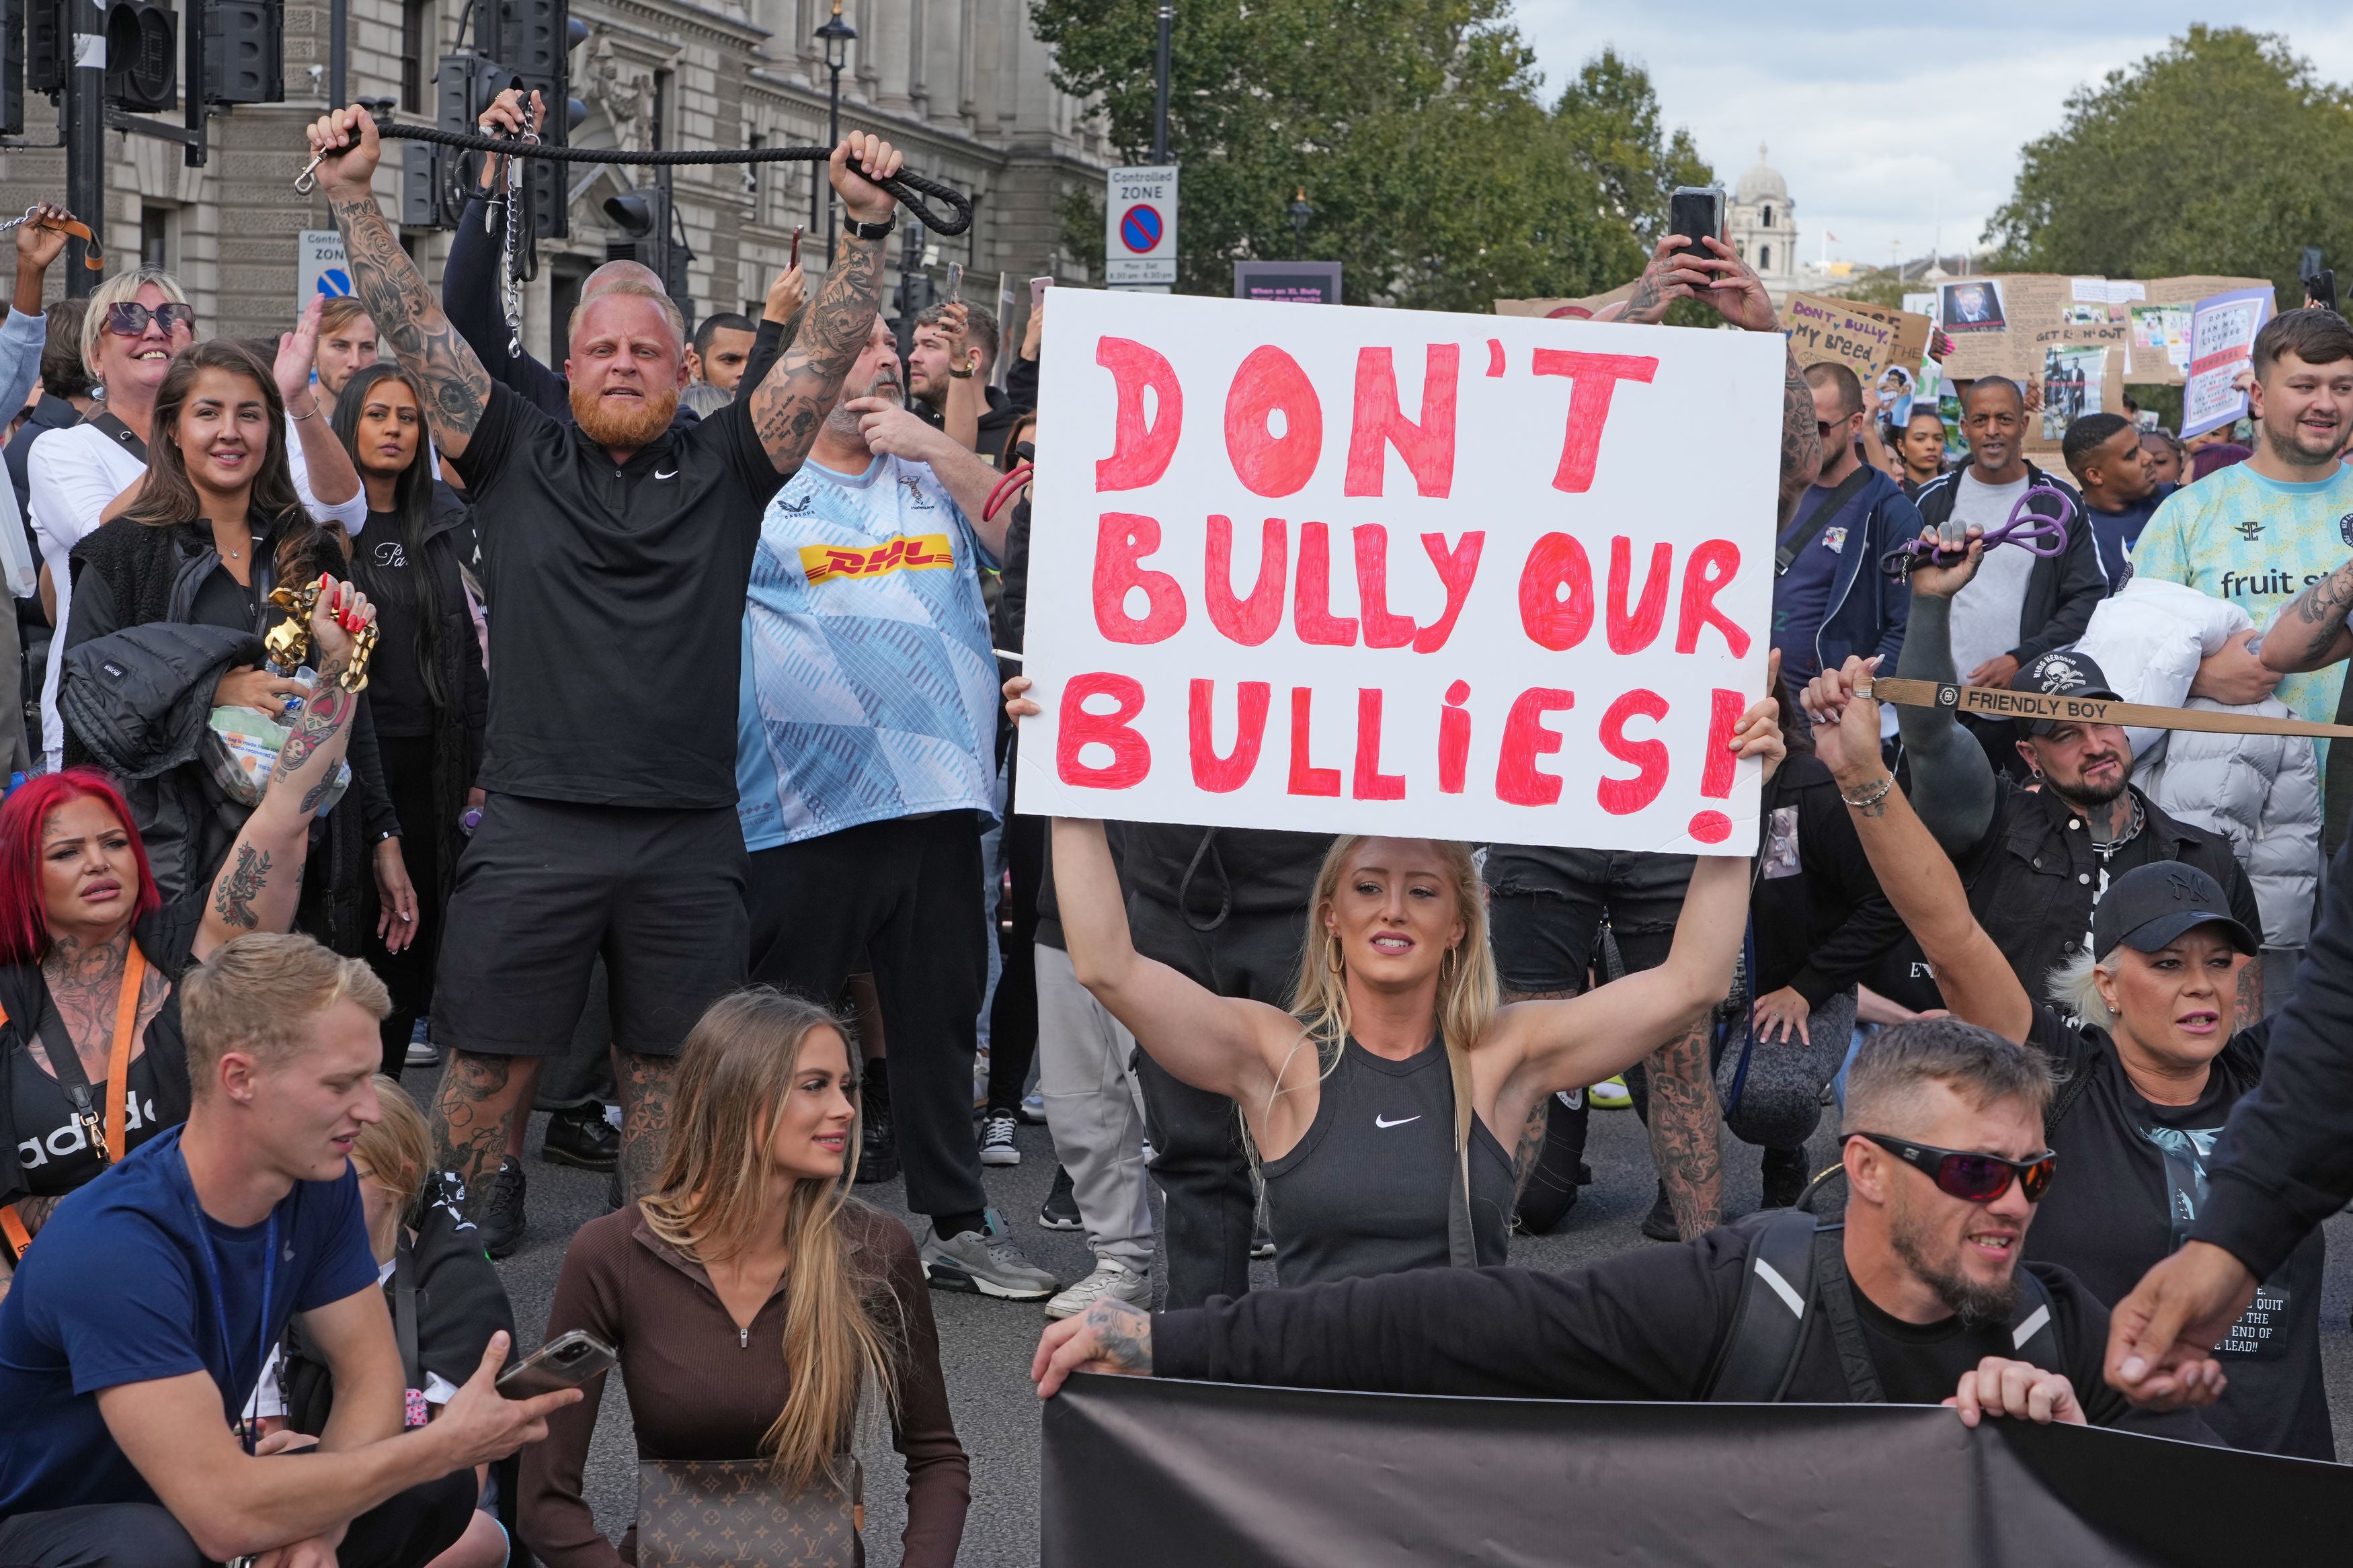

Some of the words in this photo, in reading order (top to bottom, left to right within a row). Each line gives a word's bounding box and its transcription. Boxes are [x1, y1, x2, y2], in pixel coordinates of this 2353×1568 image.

[1113, 171, 1172, 183] Controlled
[1121, 186, 1163, 199] ZONE
[1795, 323, 1821, 347] MY
[2036, 330, 2059, 341] GET
[1890, 343, 1921, 360] THE
[1096, 336, 1660, 499] DON'T
[826, 540, 934, 575] DHL
[1092, 512, 1485, 654] BULLY
[1519, 532, 1751, 659] OUR
[2221, 569, 2295, 598] fruit
[1968, 691, 2060, 715] FRIENDLY
[2068, 702, 2108, 718] BOY
[2257, 1298, 2283, 1310] QUIT
[2246, 1312, 2269, 1324] THE
[2232, 1325, 2255, 1337] END
[2259, 1327, 2272, 1338] OF
[2225, 1339, 2258, 1352] LEAD!!
